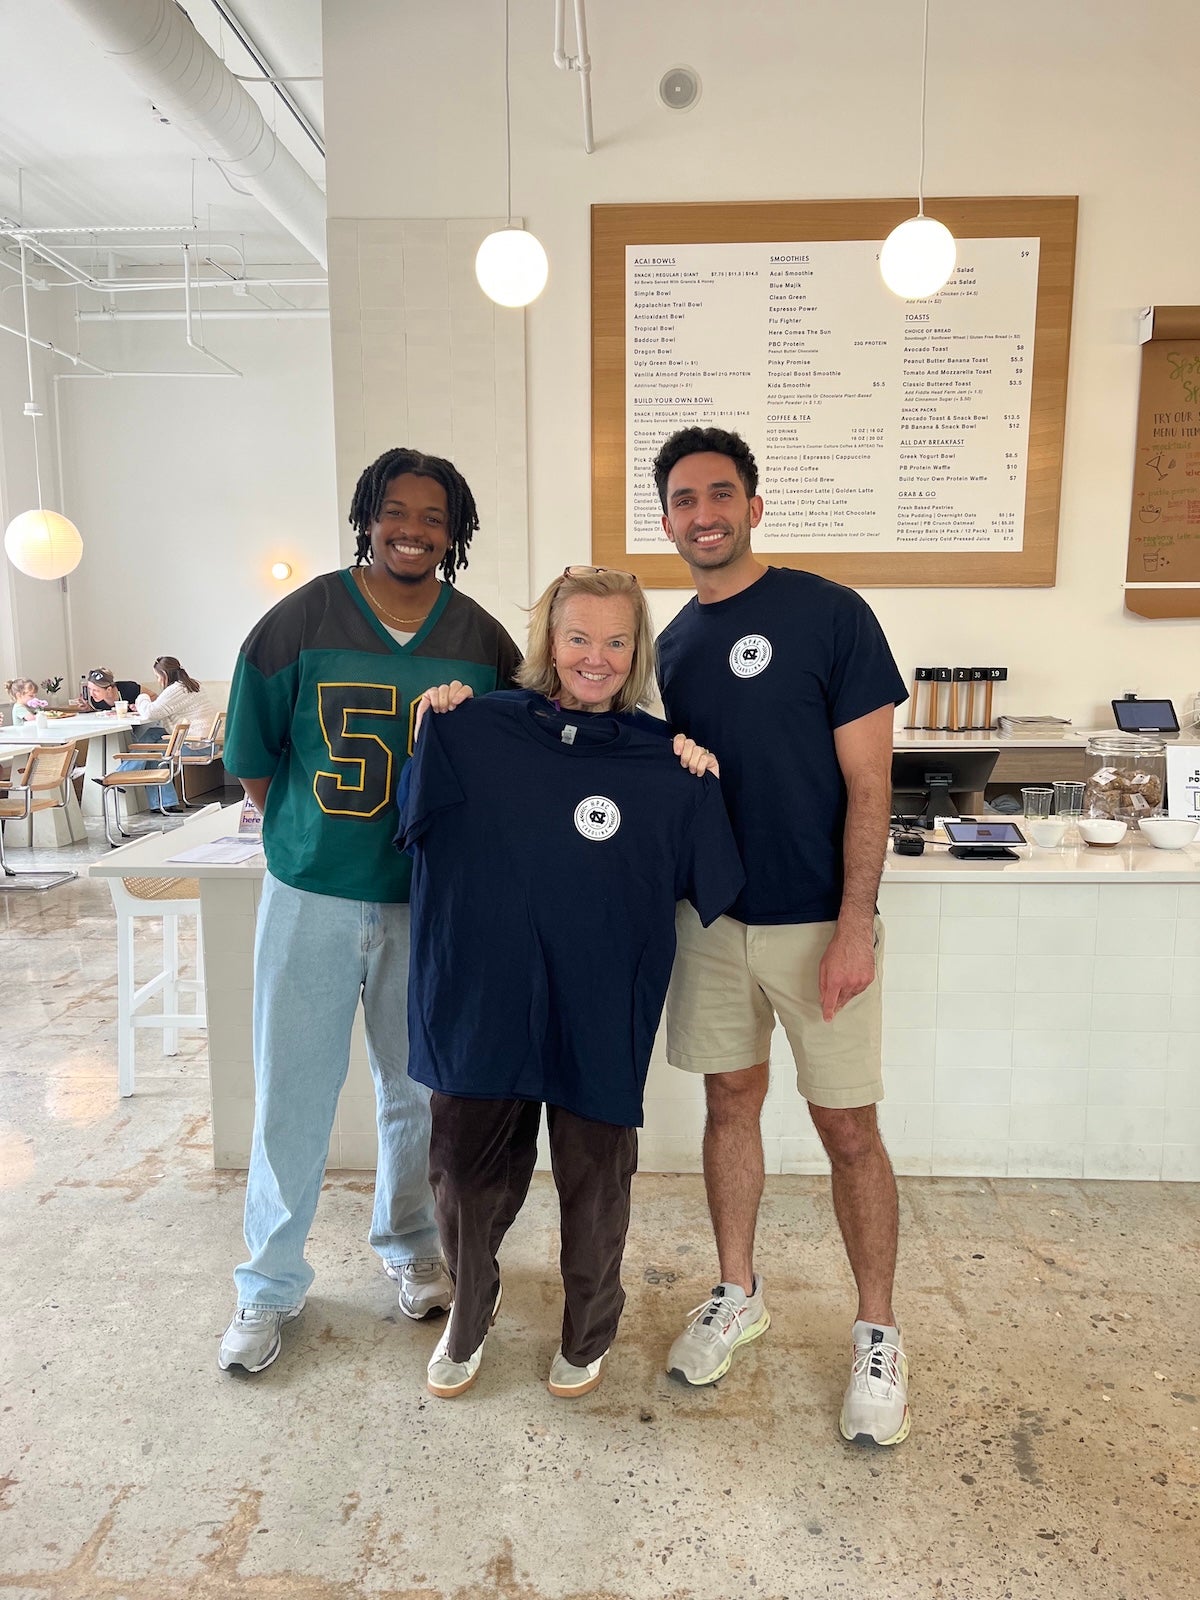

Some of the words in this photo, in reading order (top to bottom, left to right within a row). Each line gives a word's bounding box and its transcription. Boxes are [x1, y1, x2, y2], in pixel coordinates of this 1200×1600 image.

[1154, 412, 1171, 424] TRY
[1174, 412, 1192, 422] OUR
[1153, 428, 1176, 438] MENU
[312, 682, 424, 817] 5
